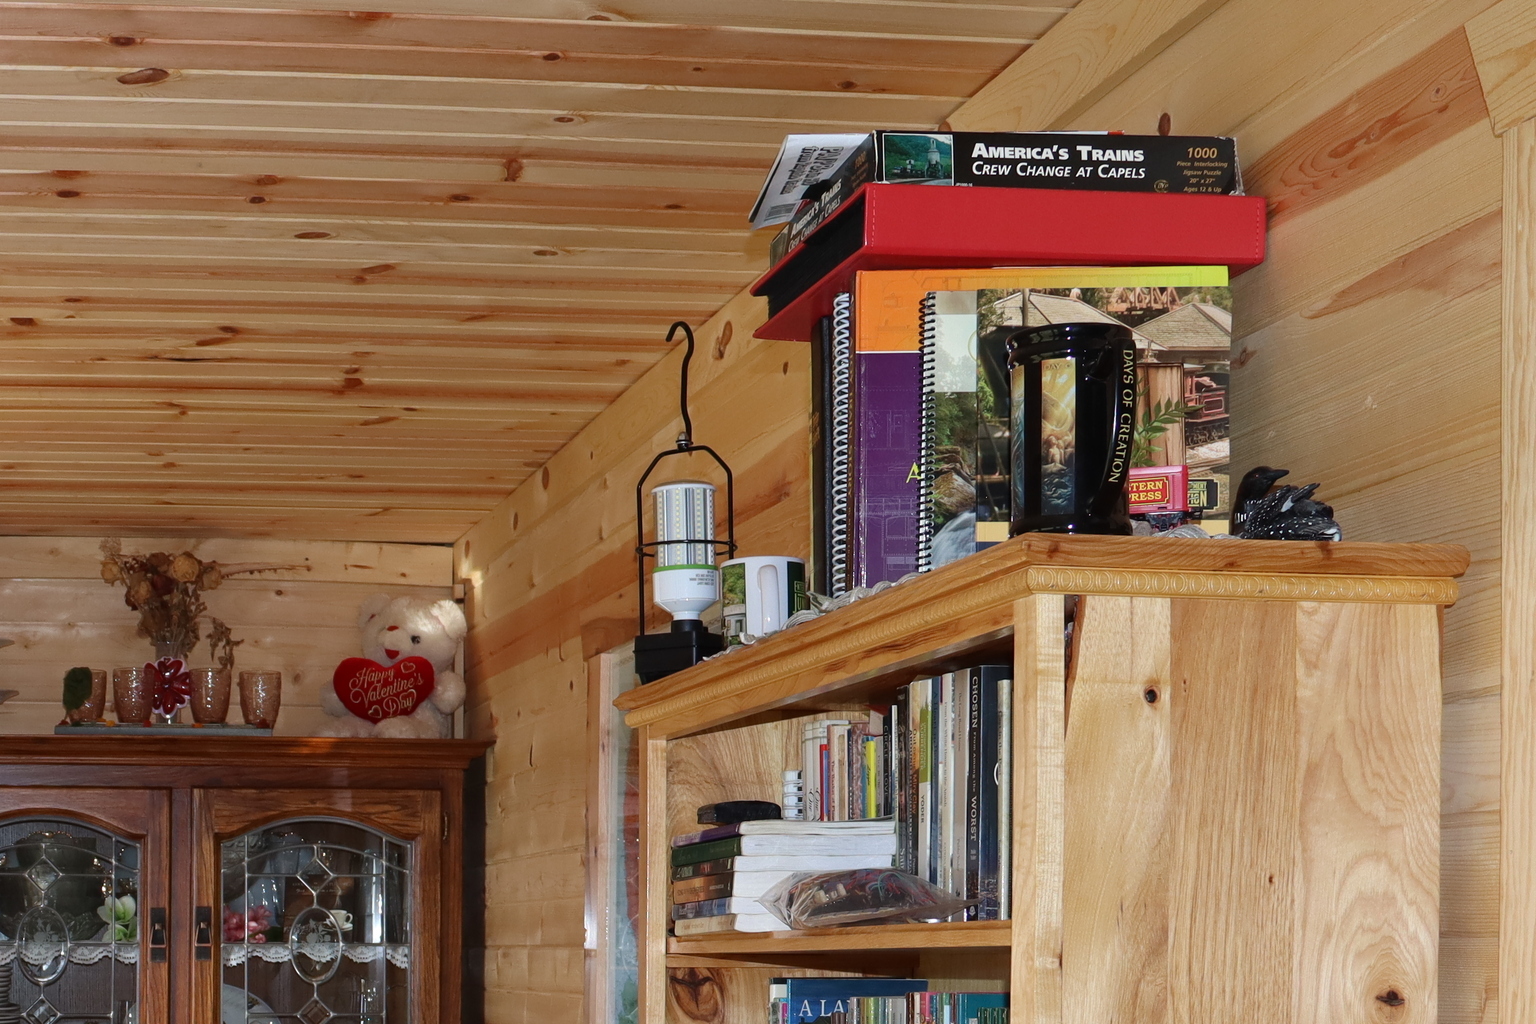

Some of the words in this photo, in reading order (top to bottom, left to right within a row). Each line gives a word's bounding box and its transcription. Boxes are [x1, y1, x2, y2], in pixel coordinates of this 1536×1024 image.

[971, 142, 1069, 160] AMERICA'S
[1076, 145, 1145, 162] TRAINS
[1187, 147, 1218, 159] 1000
[972, 161, 1012, 176] CREW
[1016, 162, 1072, 177] CHANGE
[1076, 166, 1094, 178] AT
[1097, 164, 1146, 179] CAPELS
[821, 179, 842, 207] TRAINS
[1122, 349, 1134, 384] DAYS
[1122, 389, 1134, 408] OF
[1108, 413, 1132, 483] CREATION
[349, 667, 394, 690] Happy
[350, 672, 424, 708] Valentine's
[383, 696, 413, 718] Day
[971, 676, 979, 729] CHOSEN
[970, 796, 978, 842] WORST
[798, 999, 813, 1017] A
[819, 999, 852, 1017] LA
